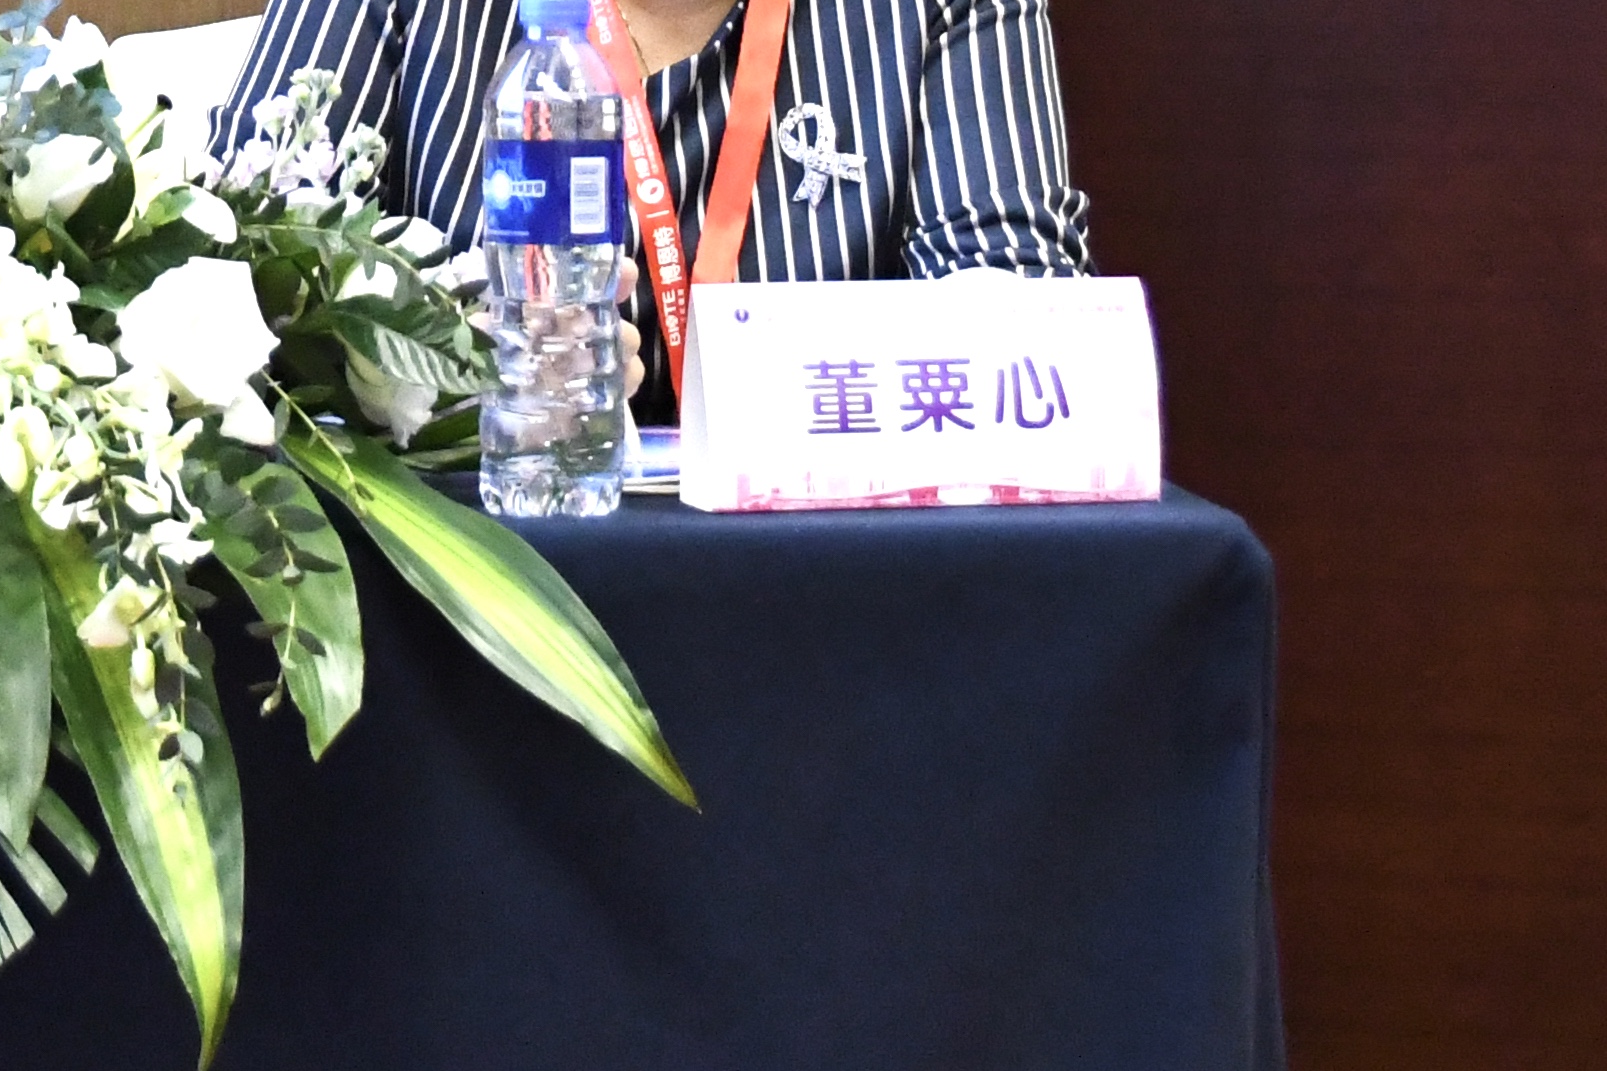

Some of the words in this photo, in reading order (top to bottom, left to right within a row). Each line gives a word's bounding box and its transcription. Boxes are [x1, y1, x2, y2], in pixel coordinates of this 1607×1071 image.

[653, 226, 682, 285] 博恩特
[803, 355, 1070, 434] 董粟心
